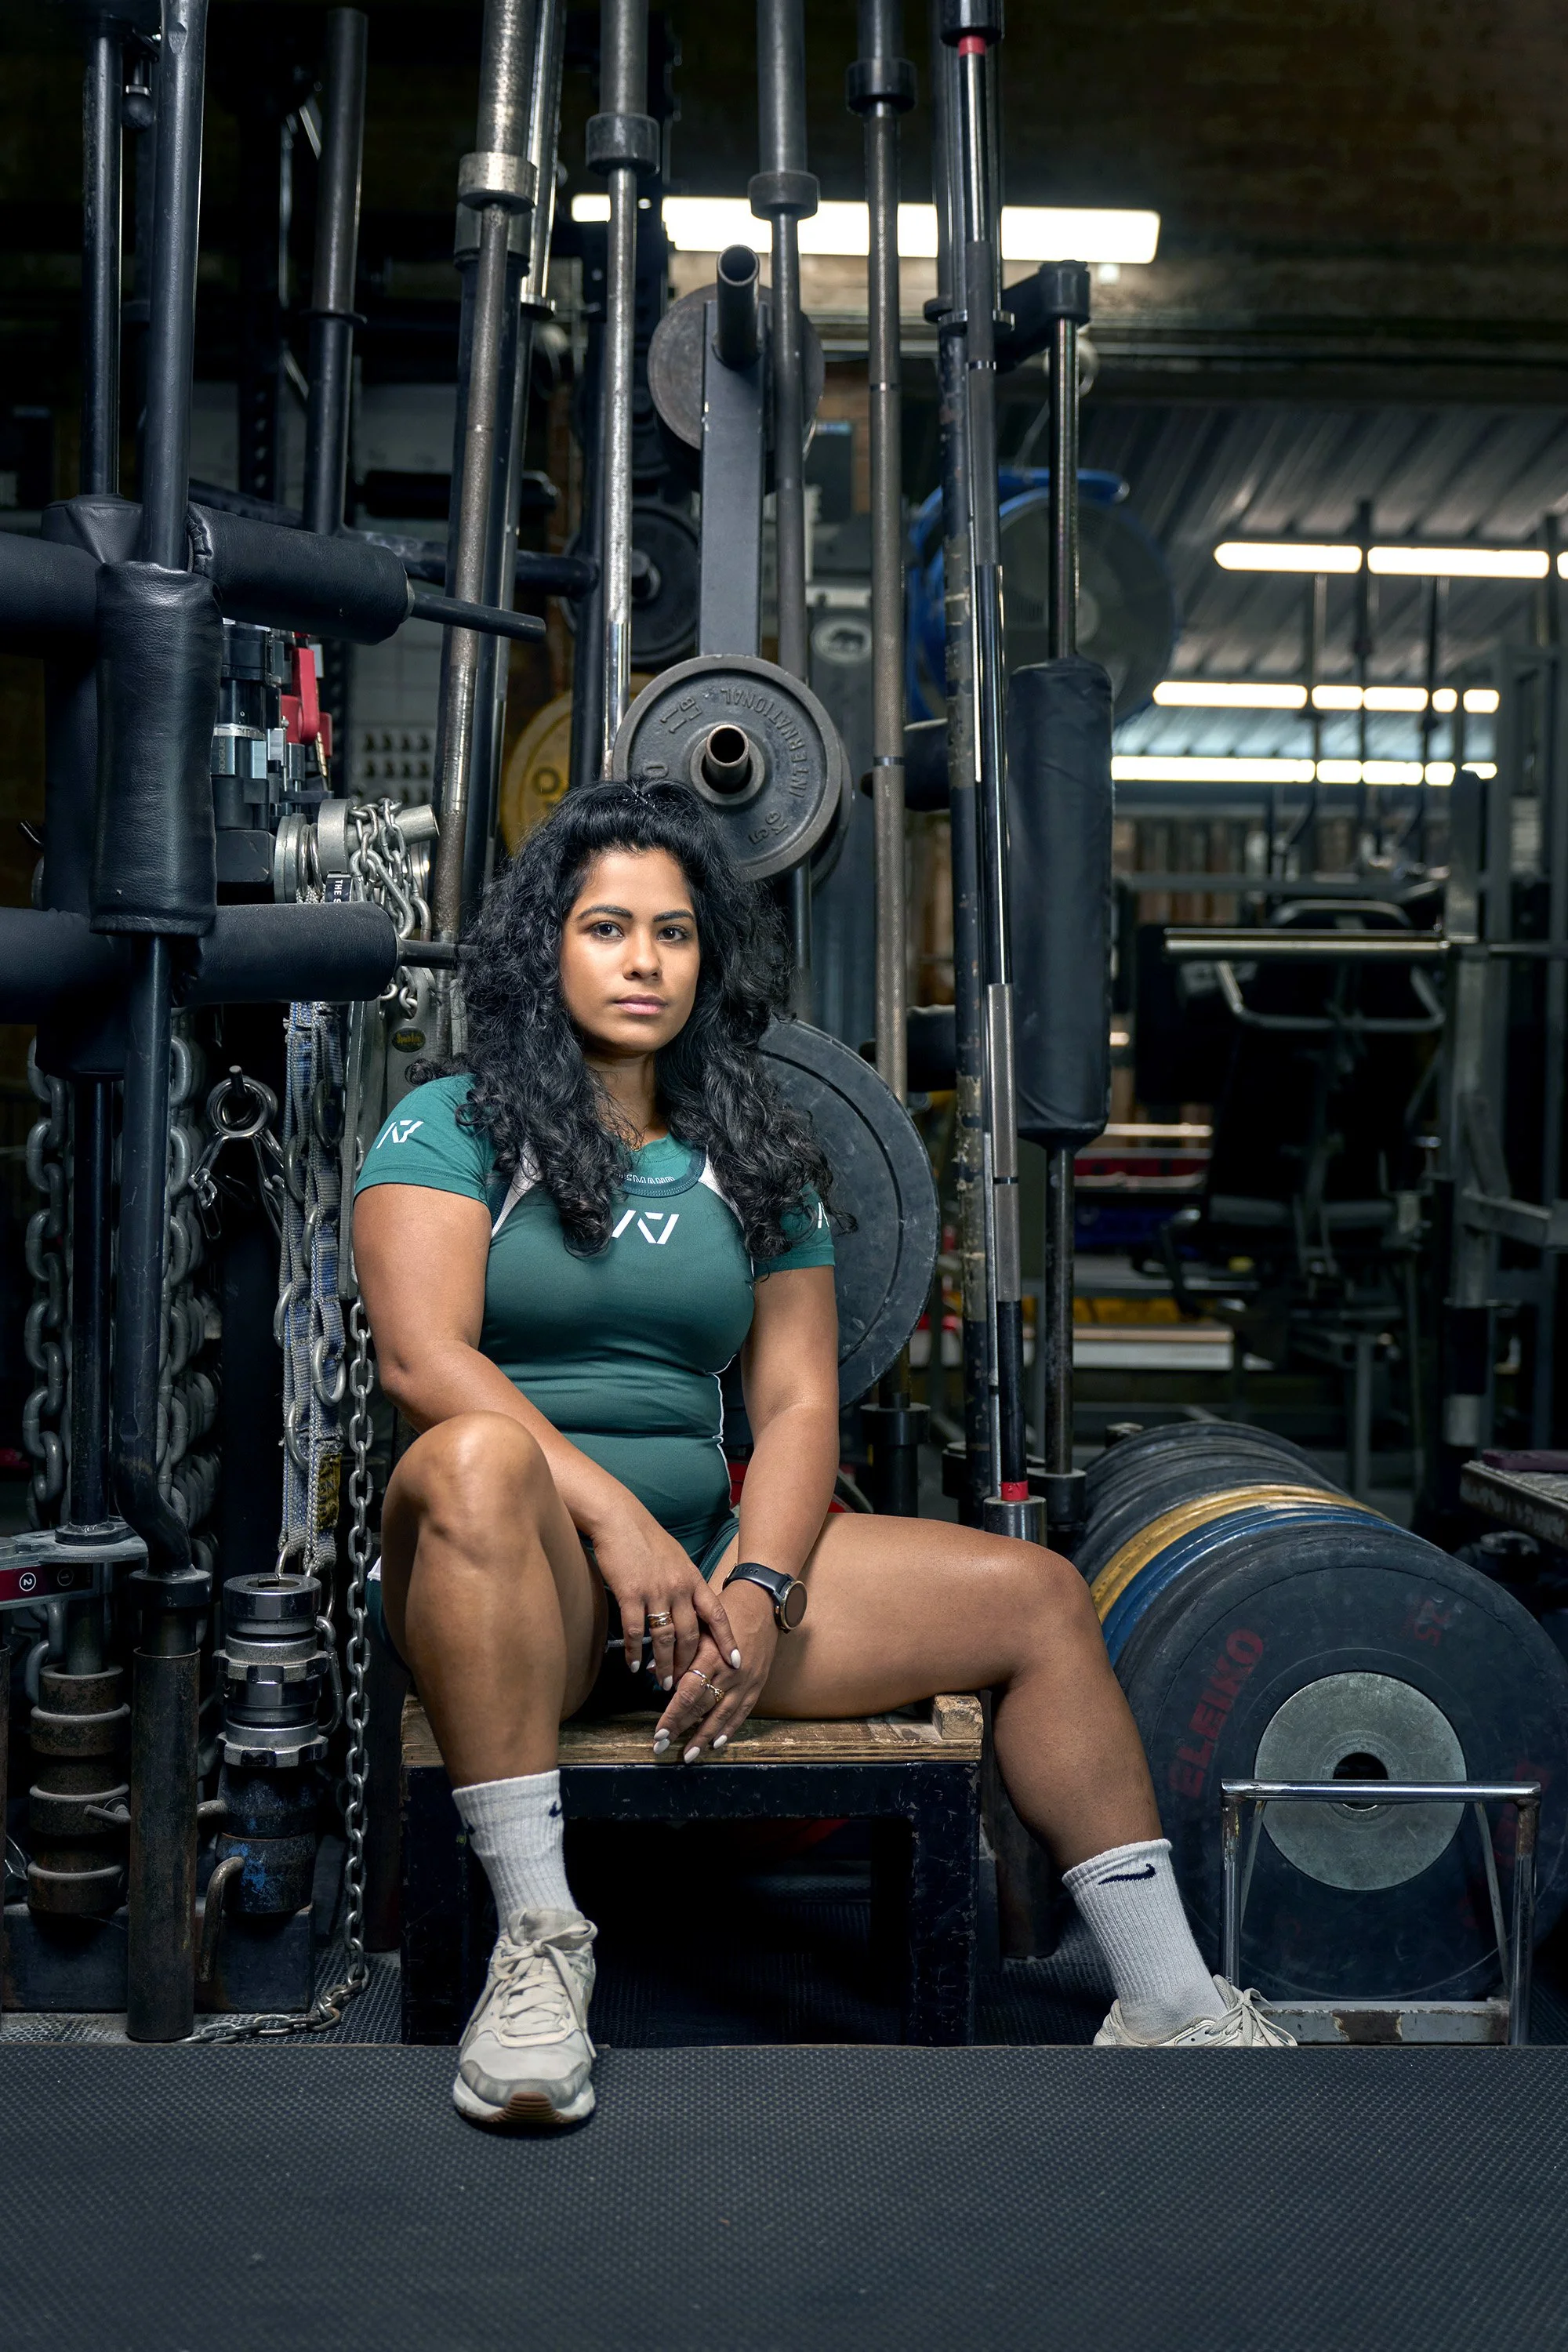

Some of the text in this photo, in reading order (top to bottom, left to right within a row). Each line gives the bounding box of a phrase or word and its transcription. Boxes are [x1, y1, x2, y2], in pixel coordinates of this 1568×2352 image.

[680, 696, 702, 720] LB
[720, 688, 809, 798] INTERNATIONAL
[748, 828, 769, 844] 5
[334, 879, 343, 895] THE
[1167, 1628, 1265, 1798] ELEIKO
